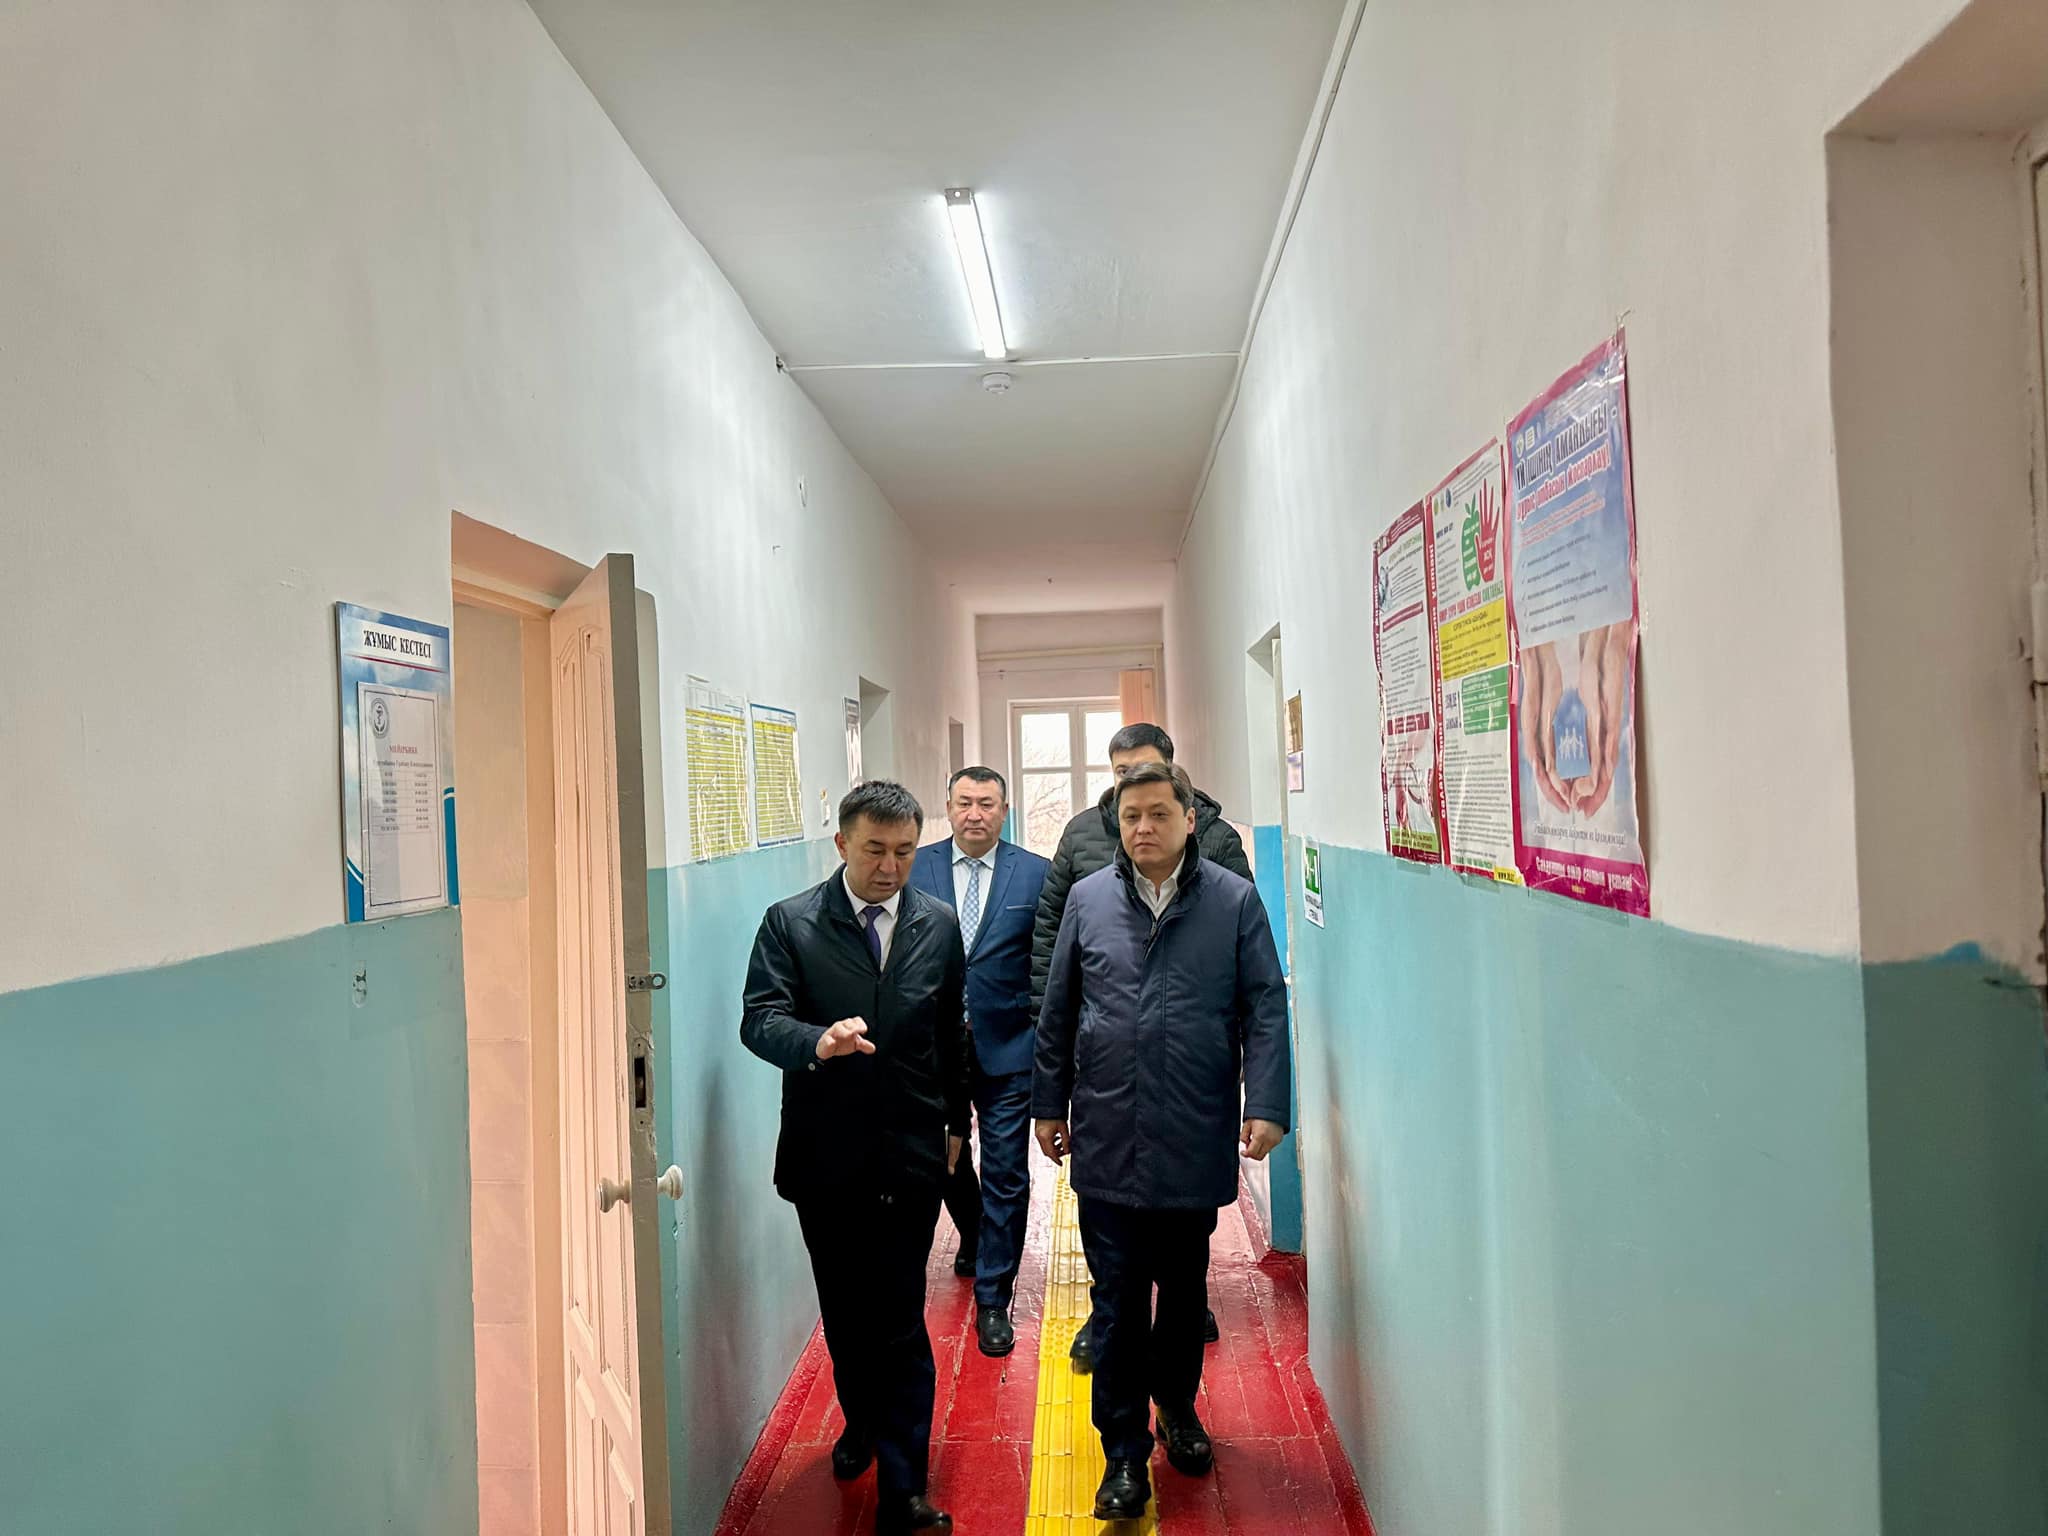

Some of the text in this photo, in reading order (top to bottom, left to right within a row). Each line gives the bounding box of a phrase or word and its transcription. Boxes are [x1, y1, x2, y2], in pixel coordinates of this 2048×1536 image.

[1555, 402, 1608, 465] АМАНДЫҒЫ
[363, 630, 431, 659] ЖҰМЫС КЕСТЕСІ
